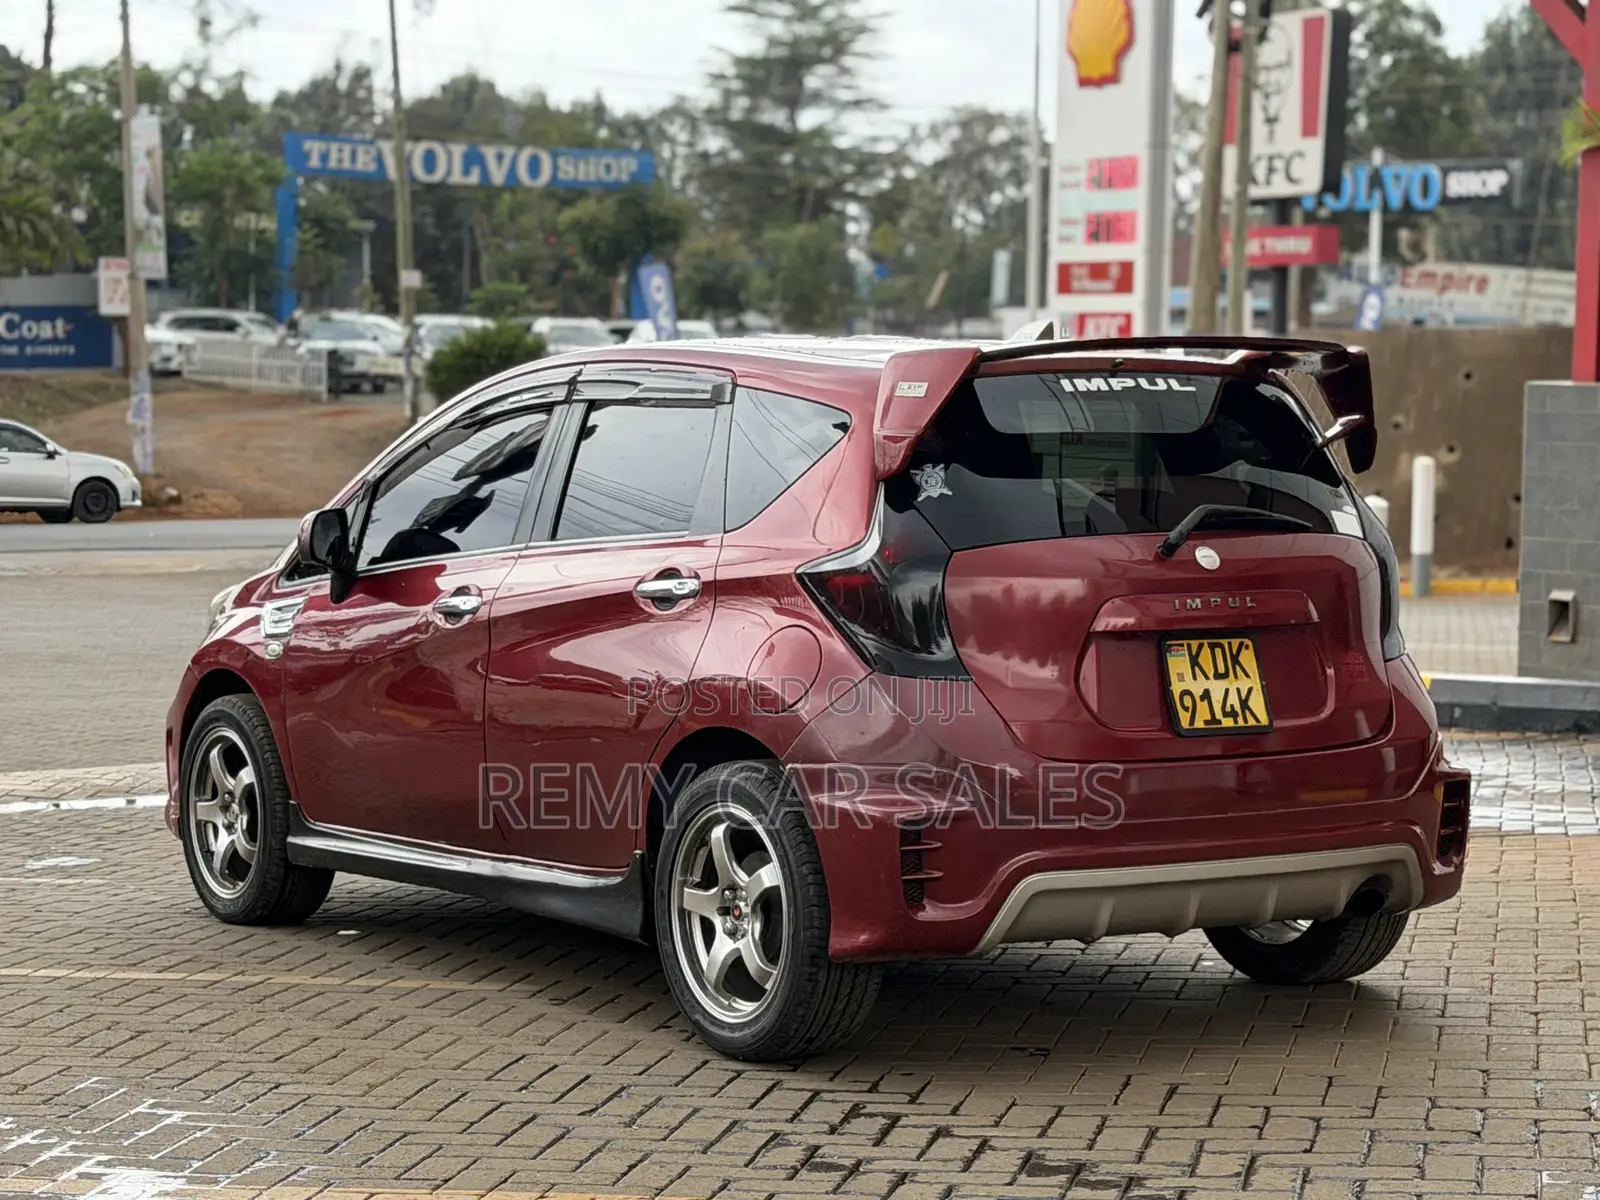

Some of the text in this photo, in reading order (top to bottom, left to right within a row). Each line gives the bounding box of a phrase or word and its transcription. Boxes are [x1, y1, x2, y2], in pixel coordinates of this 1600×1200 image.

[302, 139, 640, 189] THE VOLVO SHOP
[1446, 169, 1509, 199] SHOP
[1400, 267, 1490, 296] Empire
[1059, 377, 1197, 393] IMPUL
[1173, 596, 1257, 611] IMPUL
[1186, 640, 1252, 682] KDK
[1178, 686, 1263, 727] 914K
